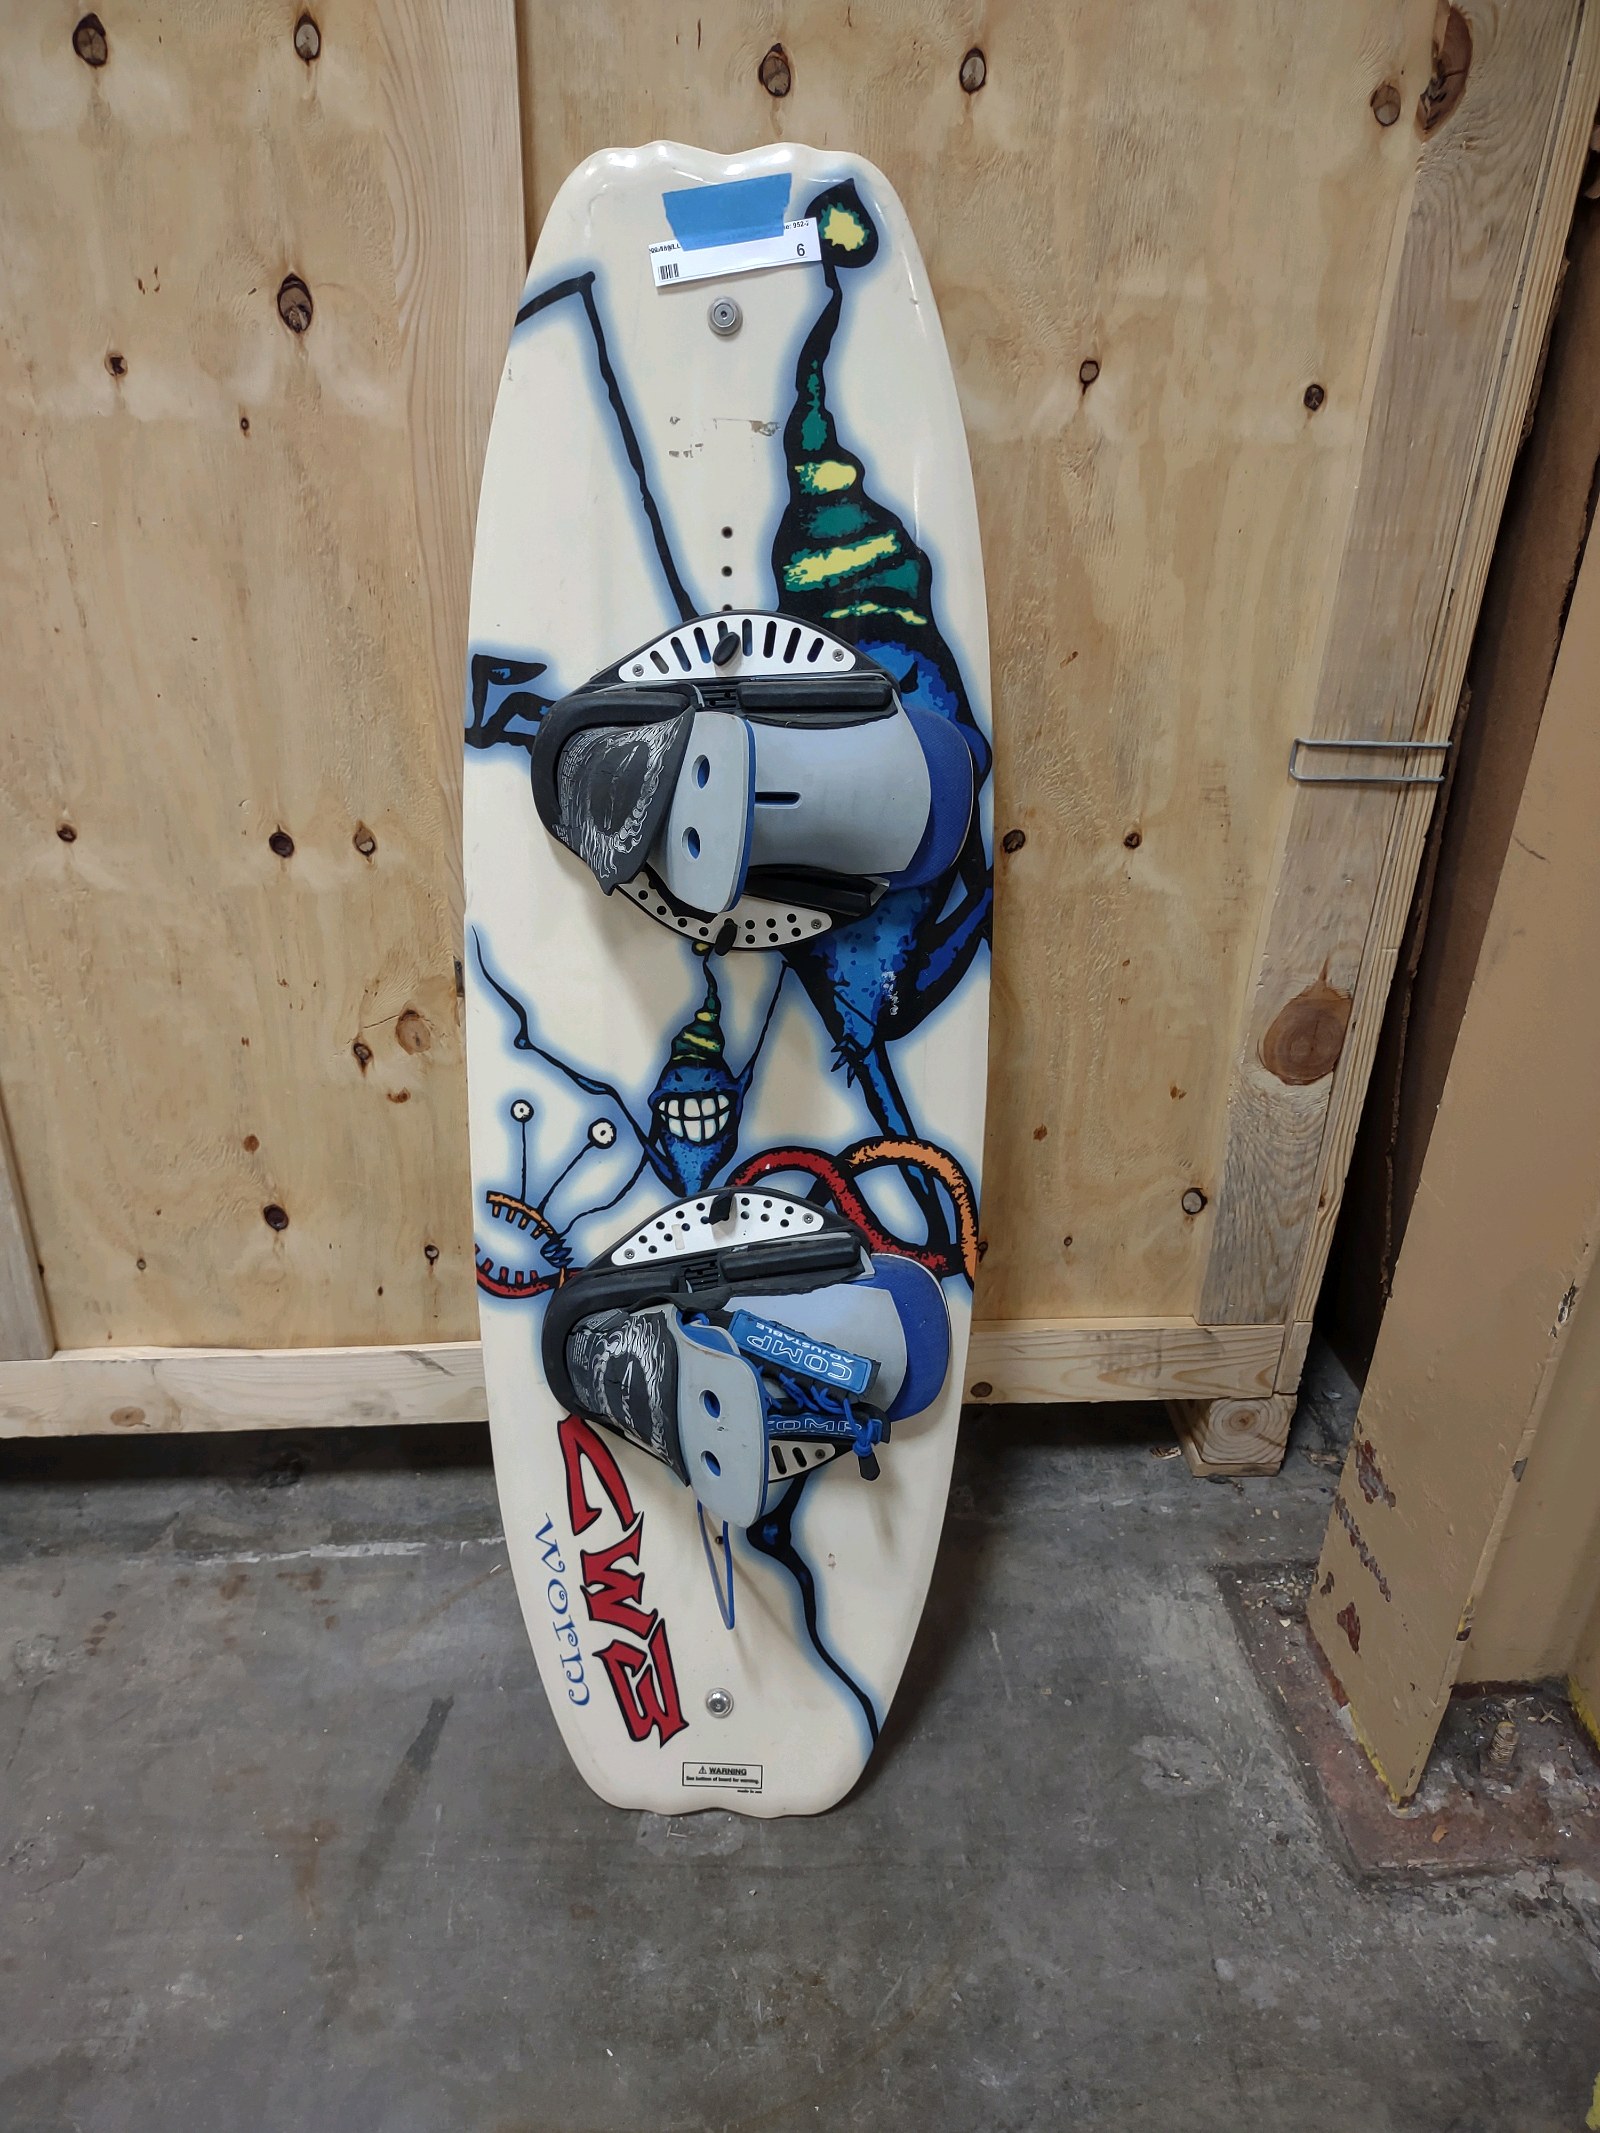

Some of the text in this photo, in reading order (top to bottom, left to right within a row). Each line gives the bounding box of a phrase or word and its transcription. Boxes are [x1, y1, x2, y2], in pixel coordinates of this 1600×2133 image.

[796, 243, 806, 257] 6
[756, 1322, 854, 1364] ADJUSTABLE
[746, 1335, 852, 1381] COMP
[767, 1418, 862, 1432] OMP
[535, 1513, 590, 1707] worm
[709, 1767, 747, 1776] WARNING
